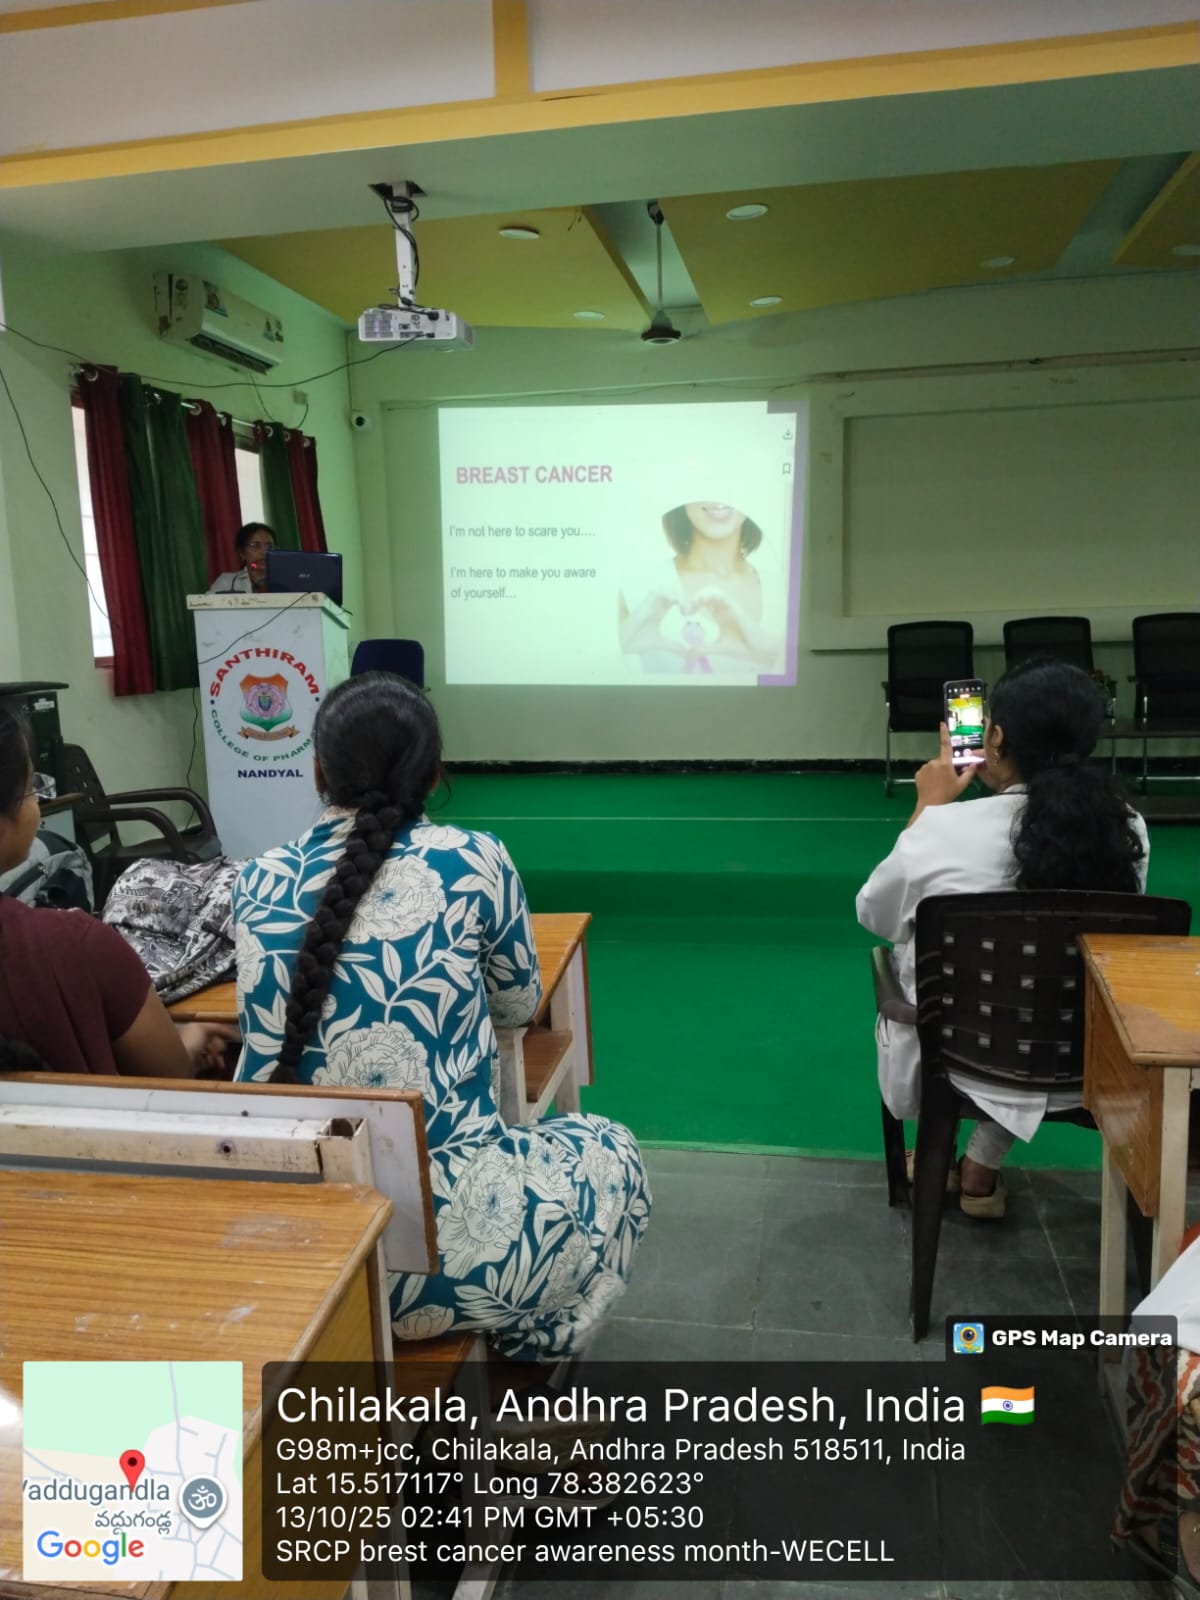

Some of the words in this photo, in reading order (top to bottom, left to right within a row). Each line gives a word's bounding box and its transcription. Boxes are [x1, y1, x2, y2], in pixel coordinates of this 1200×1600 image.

[456, 466, 530, 484] BREAST
[535, 465, 613, 483] CANCER
[468, 526, 485, 537] not
[488, 525, 512, 537] here
[515, 526, 525, 537] to
[528, 527, 558, 537] scare
[469, 566, 493, 578] here
[496, 567, 506, 578] to
[509, 566, 538, 578] make
[541, 568, 561, 581] you
[563, 568, 596, 578] aware
[450, 587, 461, 599] of
[210, 647, 320, 698] SANTHIRAM
[211, 708, 249, 759] COLLEGE
[253, 754, 270, 762] OF
[273, 738, 313, 762] PHARM
[237, 768, 304, 779] NANDYAL
